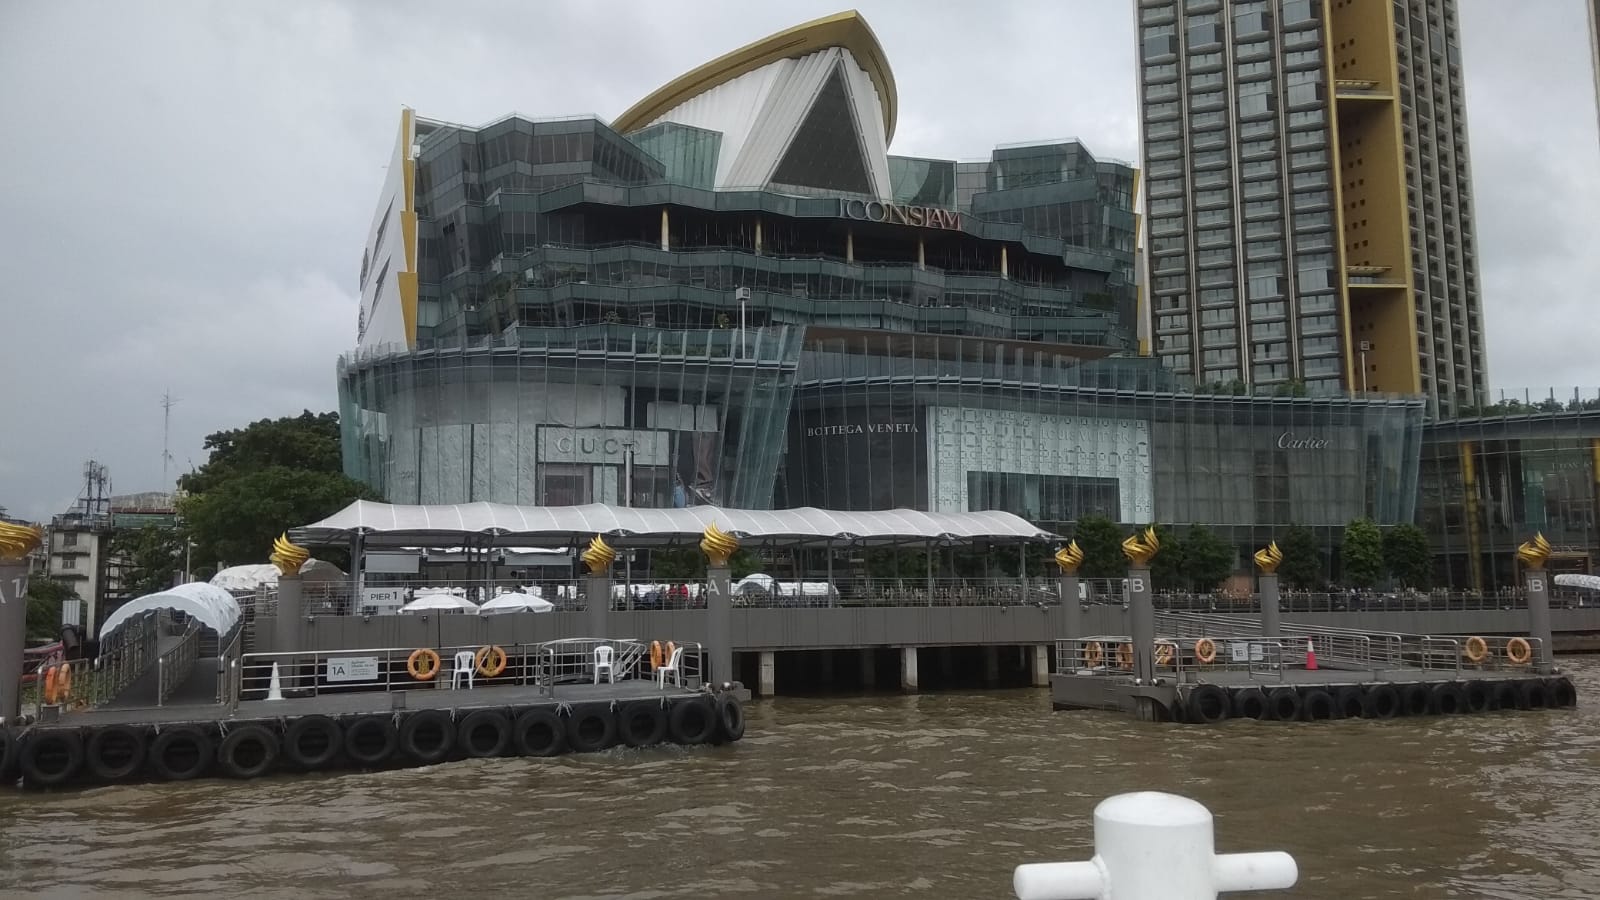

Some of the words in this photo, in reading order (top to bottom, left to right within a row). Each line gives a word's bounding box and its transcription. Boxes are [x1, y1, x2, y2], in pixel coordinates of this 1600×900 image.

[840, 199, 960, 231] ICONSIAM
[807, 424, 863, 437] BOTTEGA
[868, 423, 918, 433] VENETA
[1278, 431, 1329, 449] Cartier
[370, 593, 391, 601] PIER
[393, 591, 398, 600] 1
[332, 666, 345, 677] 1A
